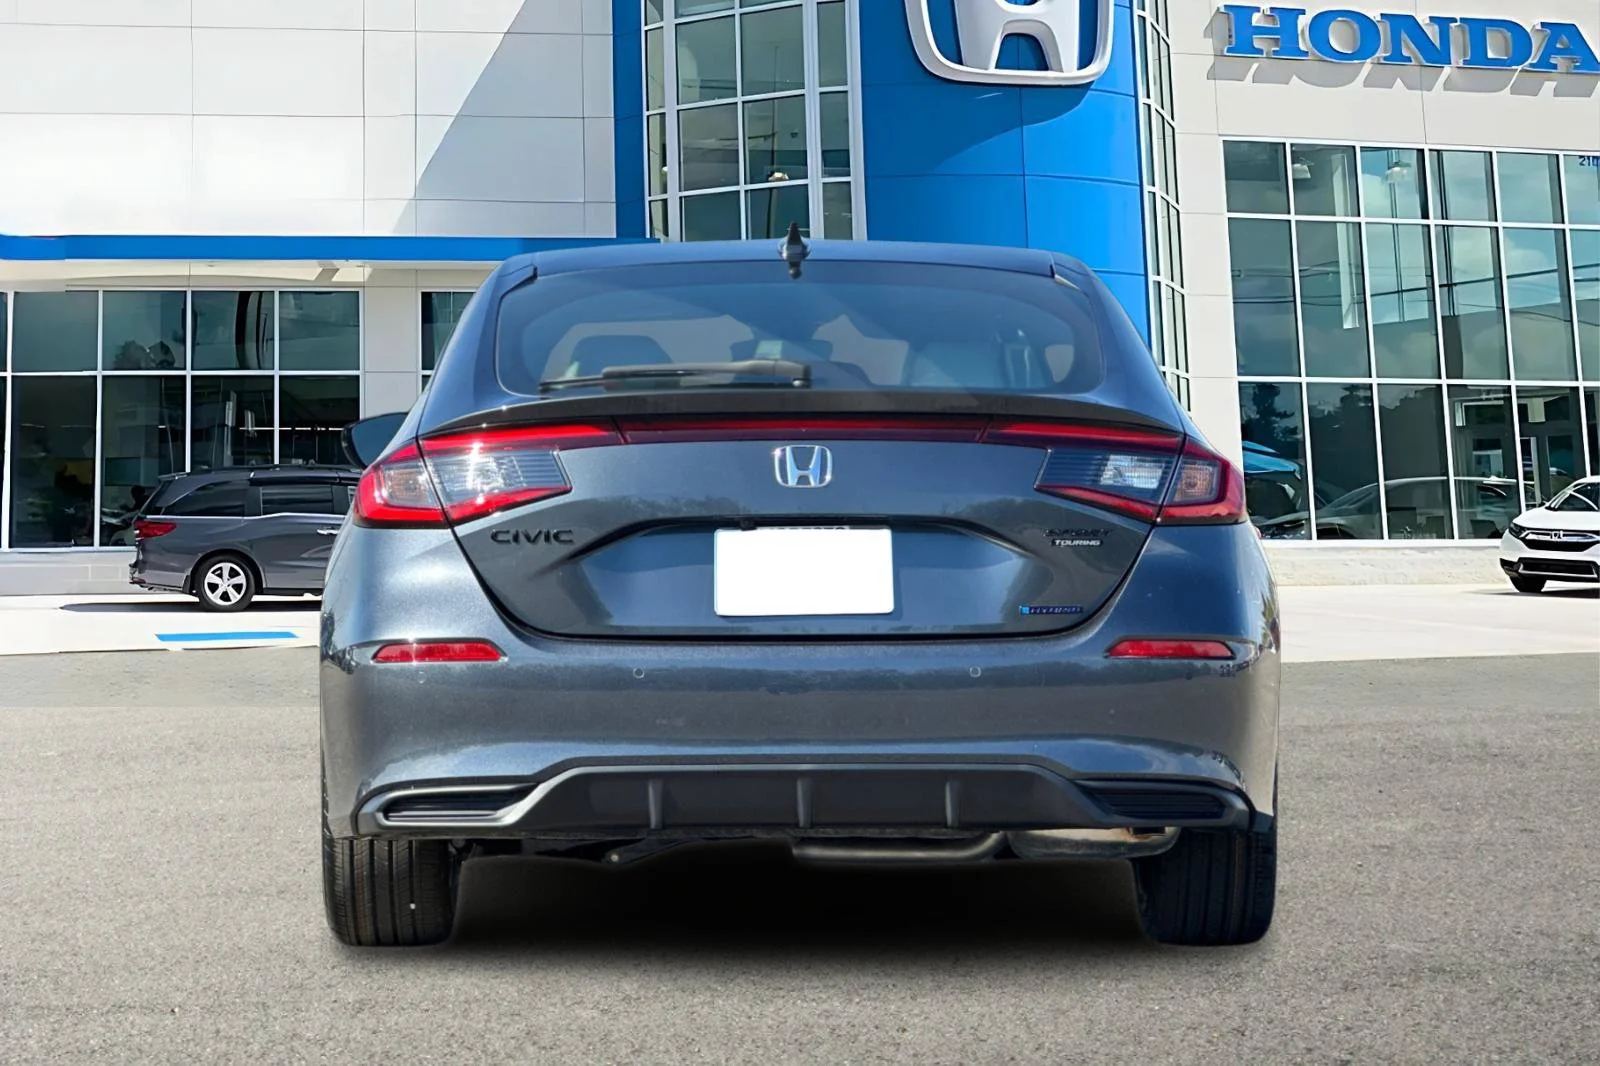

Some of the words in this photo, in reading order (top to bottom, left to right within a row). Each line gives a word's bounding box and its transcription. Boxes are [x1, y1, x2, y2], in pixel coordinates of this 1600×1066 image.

[1223, 4, 1600, 73] HONDA
[490, 529, 574, 545] CIVIC
[1053, 539, 1101, 547] TOURING
